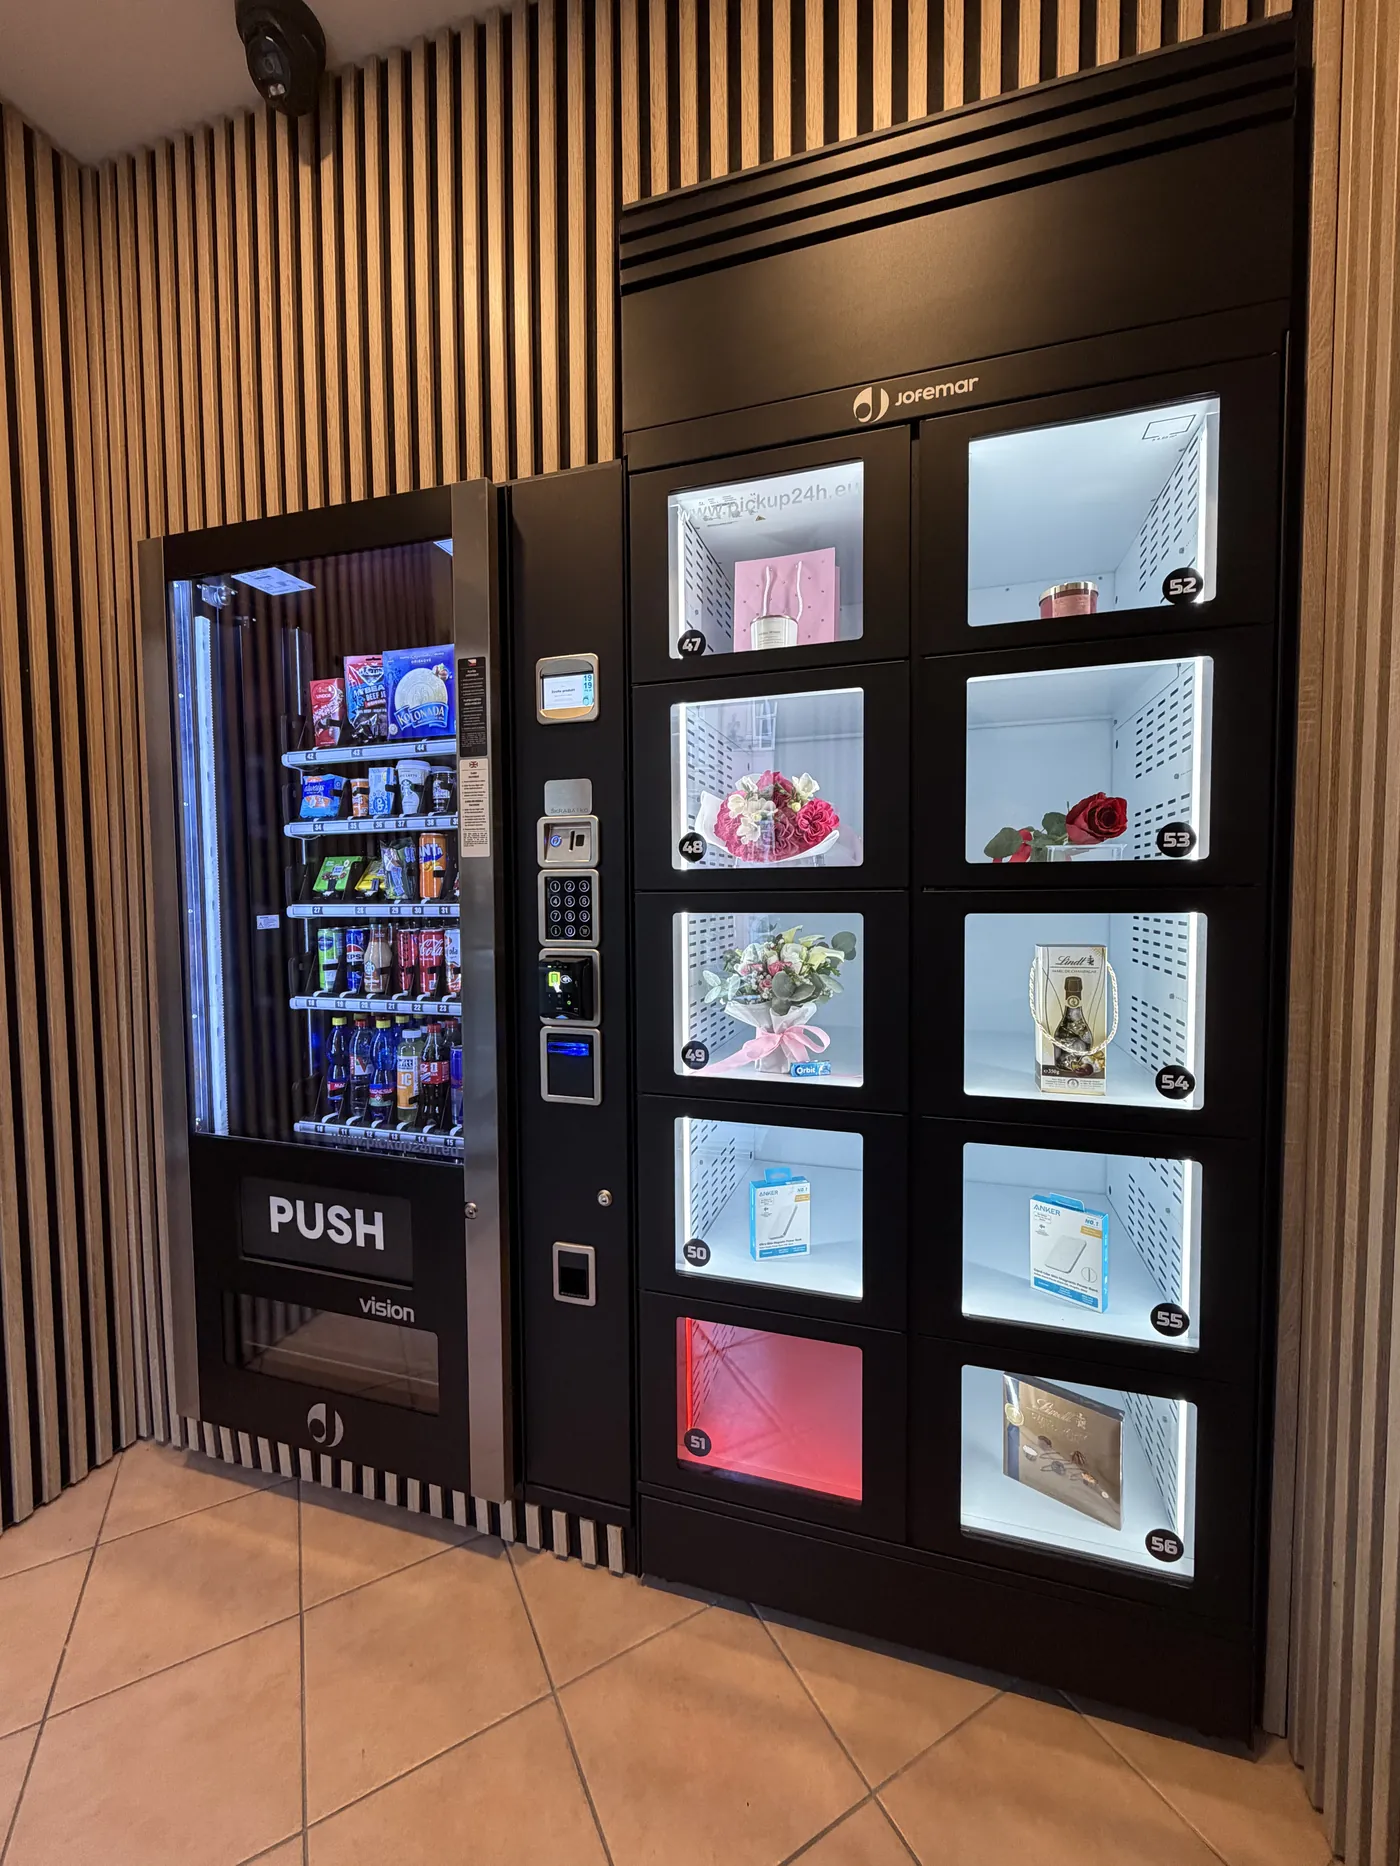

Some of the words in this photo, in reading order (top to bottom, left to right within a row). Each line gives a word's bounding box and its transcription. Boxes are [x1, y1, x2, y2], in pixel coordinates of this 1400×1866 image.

[1169, 577, 1197, 595] 52
[682, 637, 701, 651] 47
[397, 705, 445, 725] KOLONADA
[682, 840, 703, 854] 48
[1163, 833, 1190, 848] 53
[1055, 955, 1087, 966] Lindt
[685, 1049, 705, 1062] 49
[796, 1065, 815, 1074] Orbit
[1161, 1075, 1189, 1090] 54
[759, 1189, 778, 1197] ANKER
[1033, 1204, 1061, 1217] ANKER
[269, 1195, 385, 1251] PUSH
[687, 1245, 707, 1260] 50
[359, 1296, 415, 1323] vision
[1156, 1311, 1183, 1329] 55
[690, 1435, 706, 1450] 51
[1151, 1536, 1178, 1555] 56
